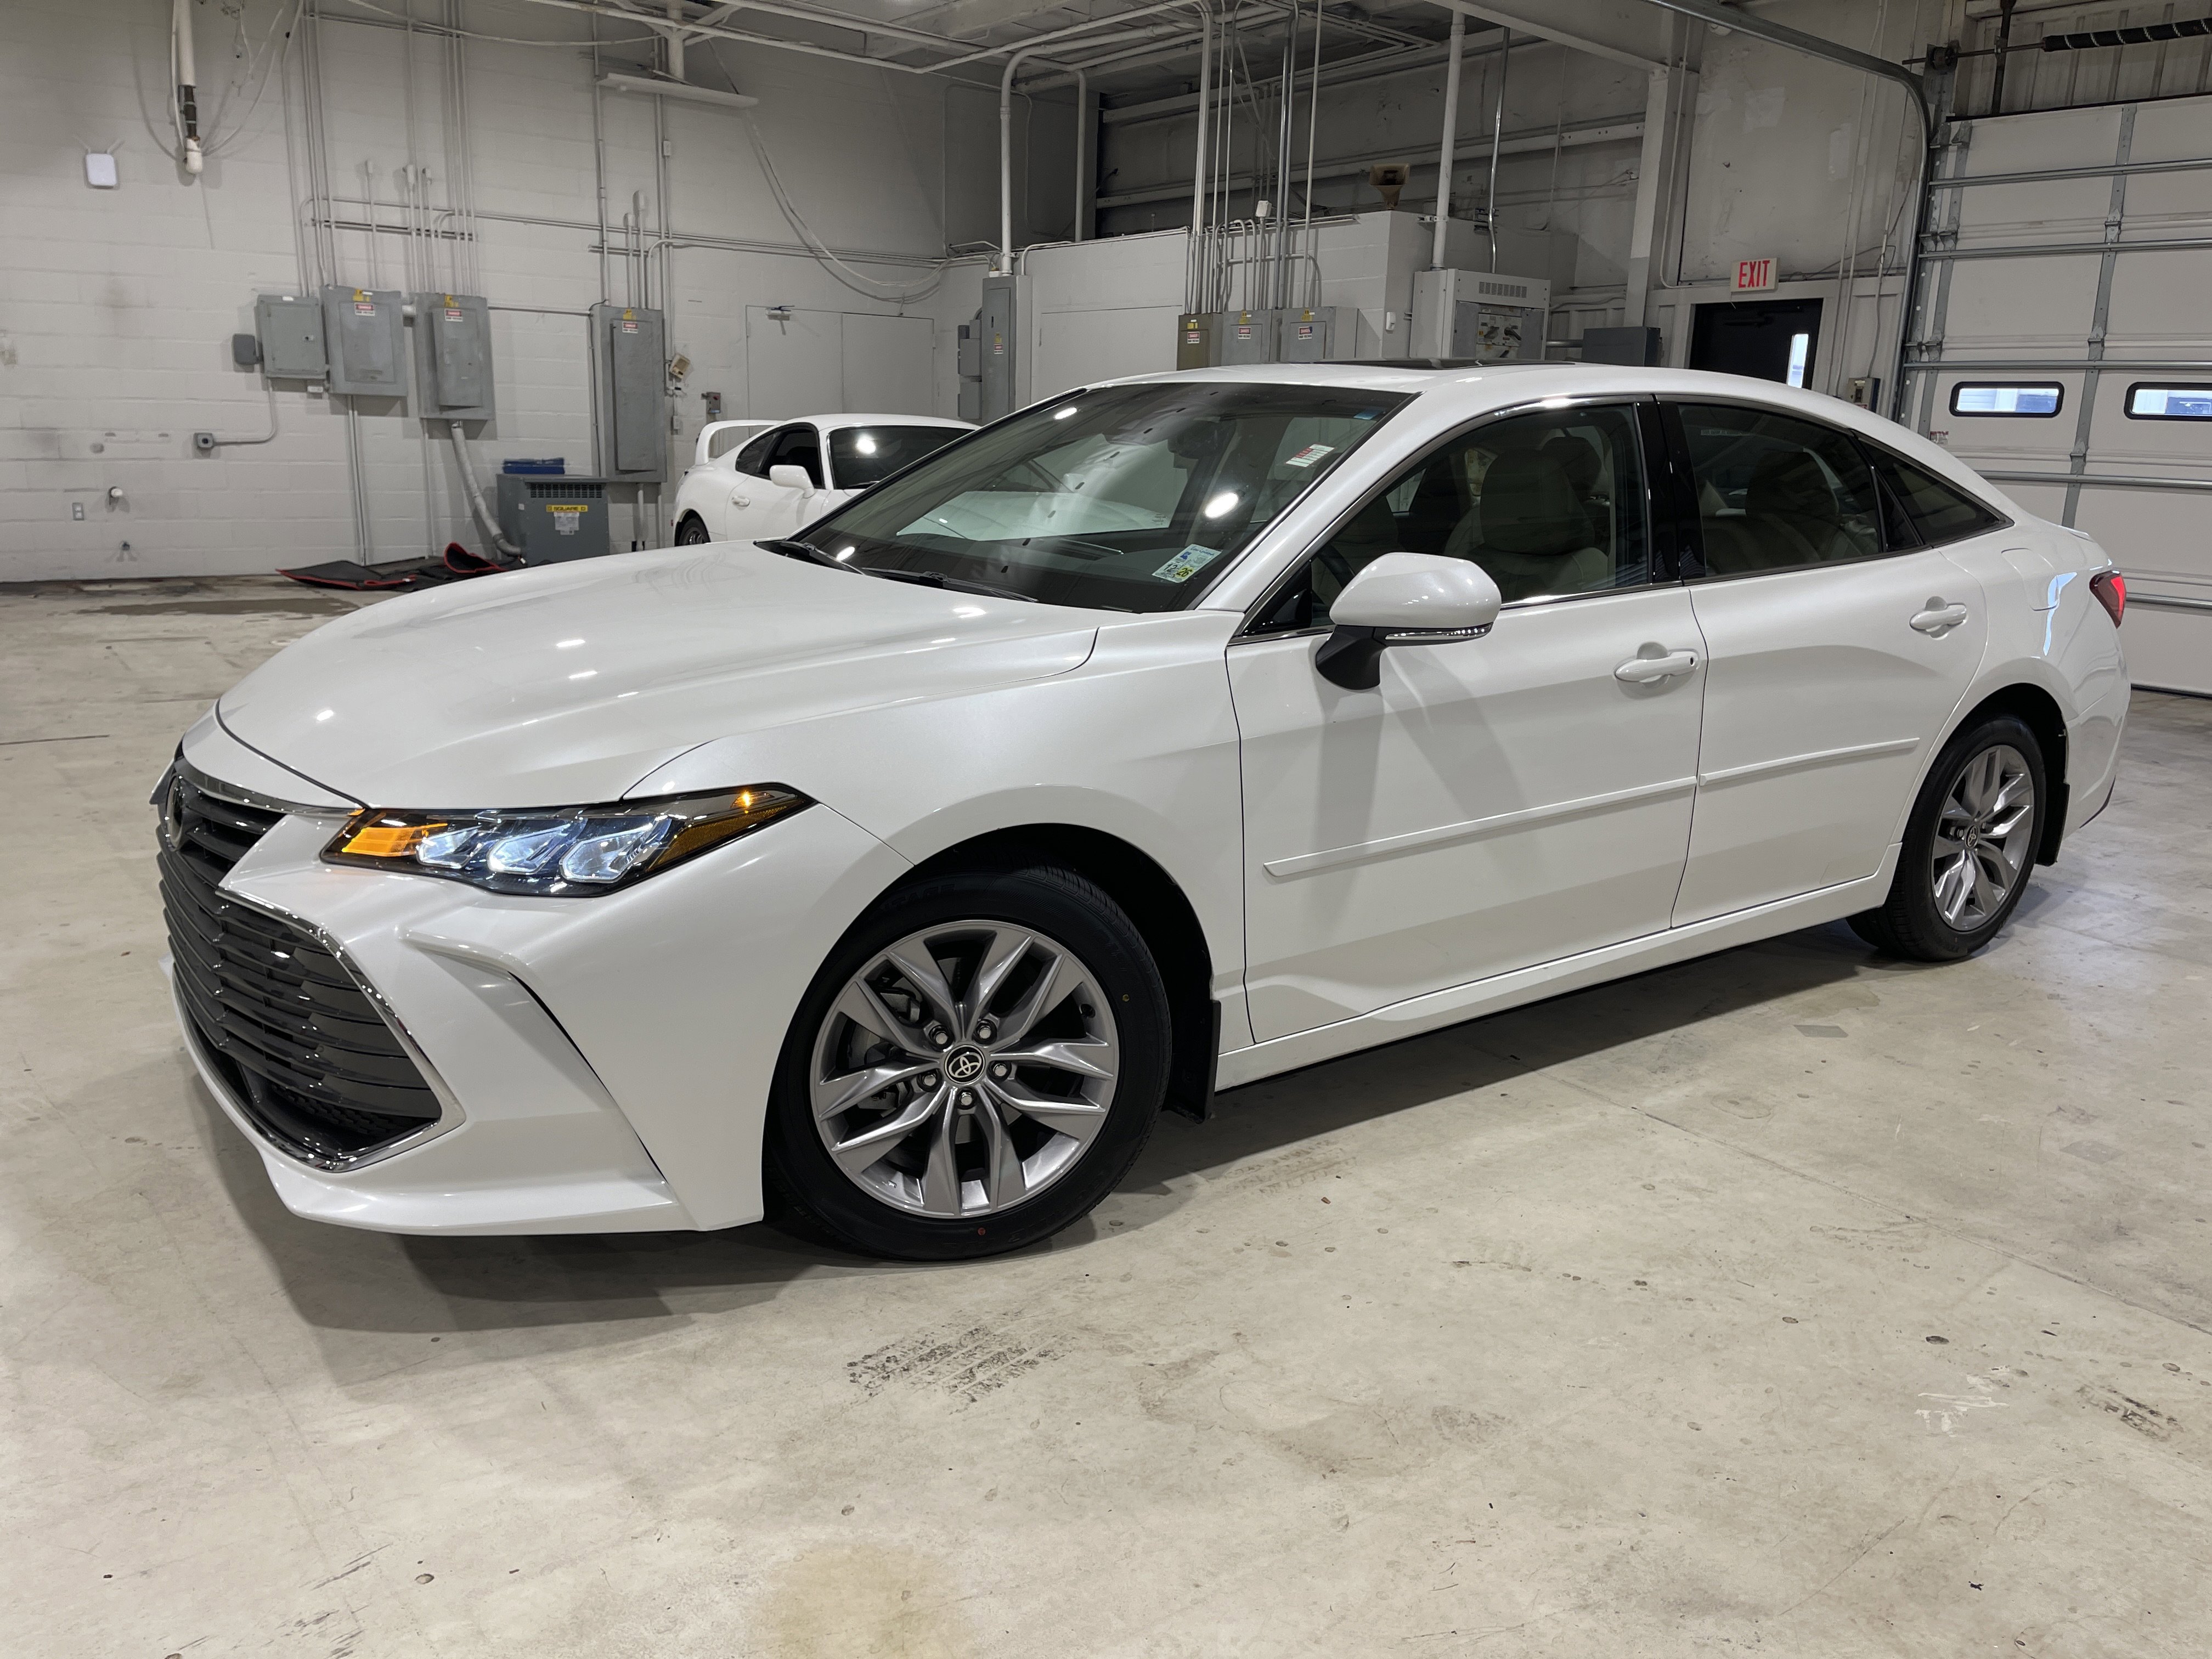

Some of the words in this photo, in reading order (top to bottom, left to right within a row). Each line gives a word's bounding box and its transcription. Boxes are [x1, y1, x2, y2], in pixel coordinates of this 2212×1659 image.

[1738, 259, 1770, 289] EXIT
[1163, 563, 1178, 573] 12
[1176, 567, 1193, 577] 26
